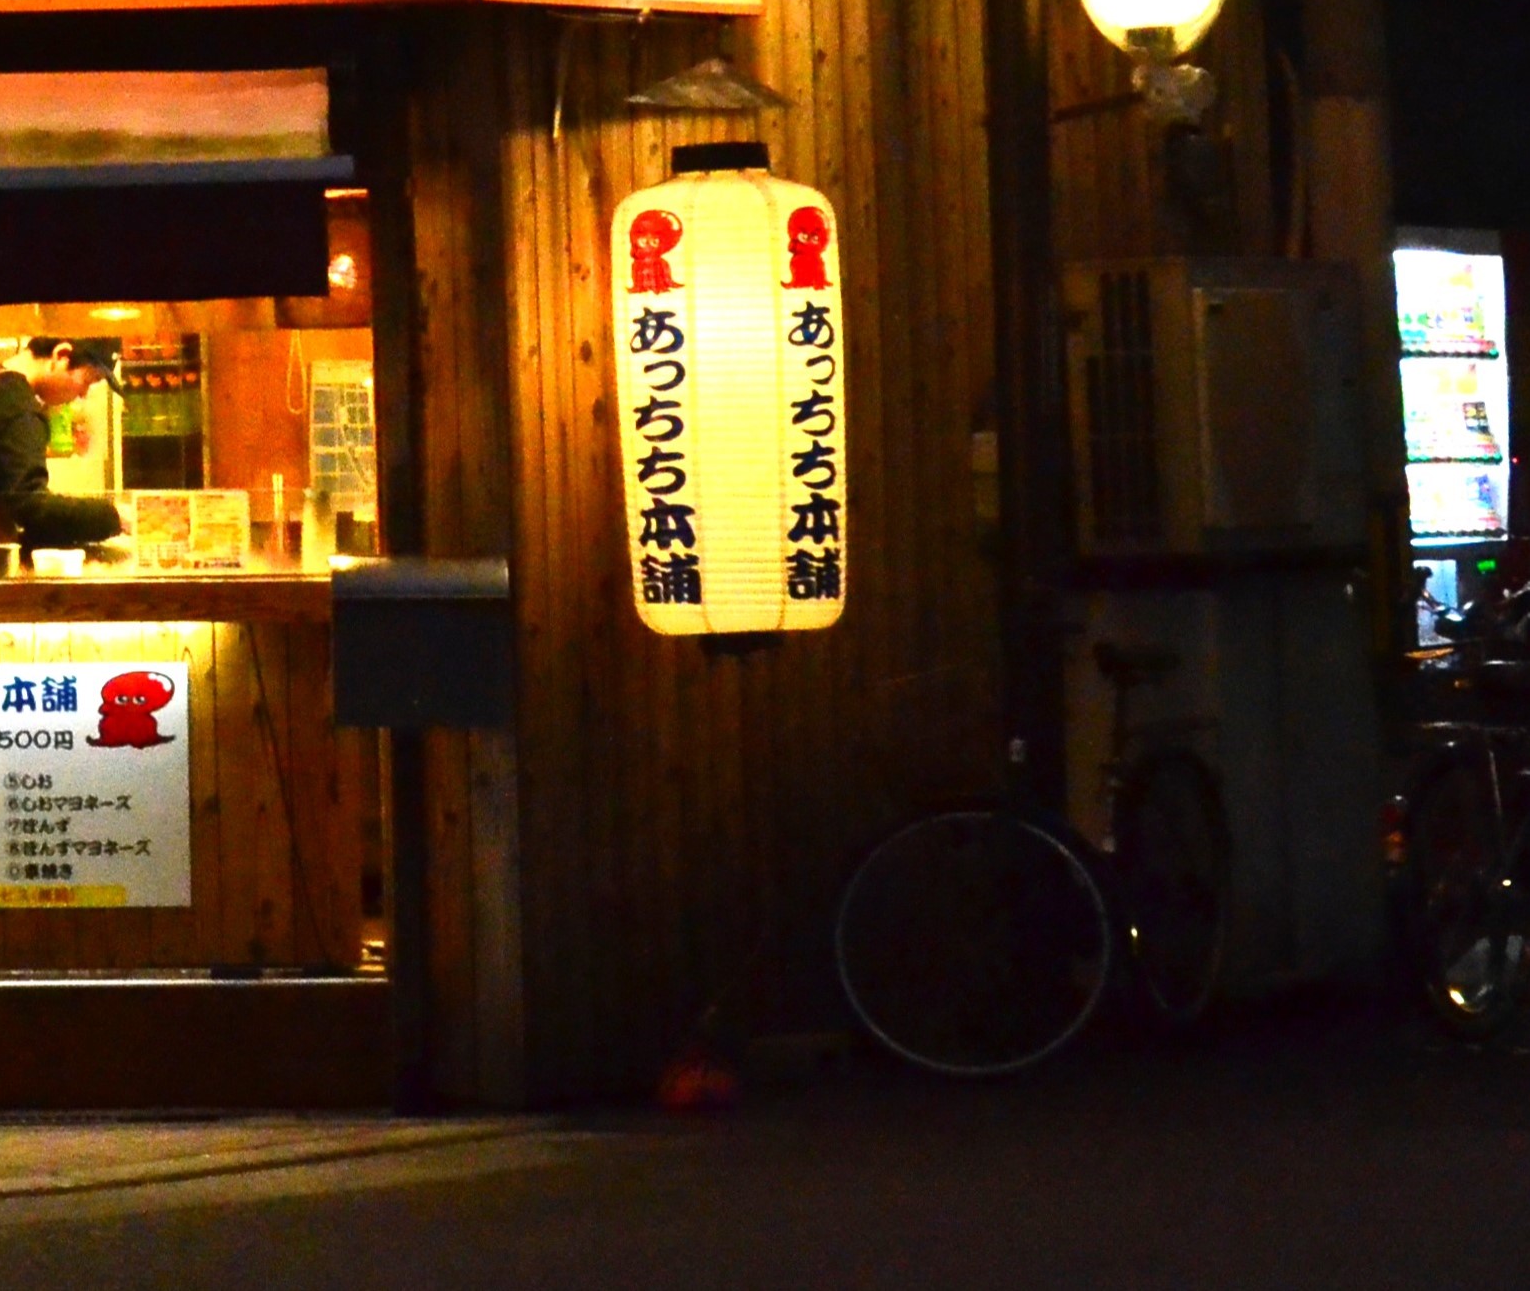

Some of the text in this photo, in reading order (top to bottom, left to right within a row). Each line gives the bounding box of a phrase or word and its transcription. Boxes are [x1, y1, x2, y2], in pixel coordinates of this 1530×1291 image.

[630, 307, 703, 605] あっちち本舗
[787, 300, 841, 601] あっちち本舗
